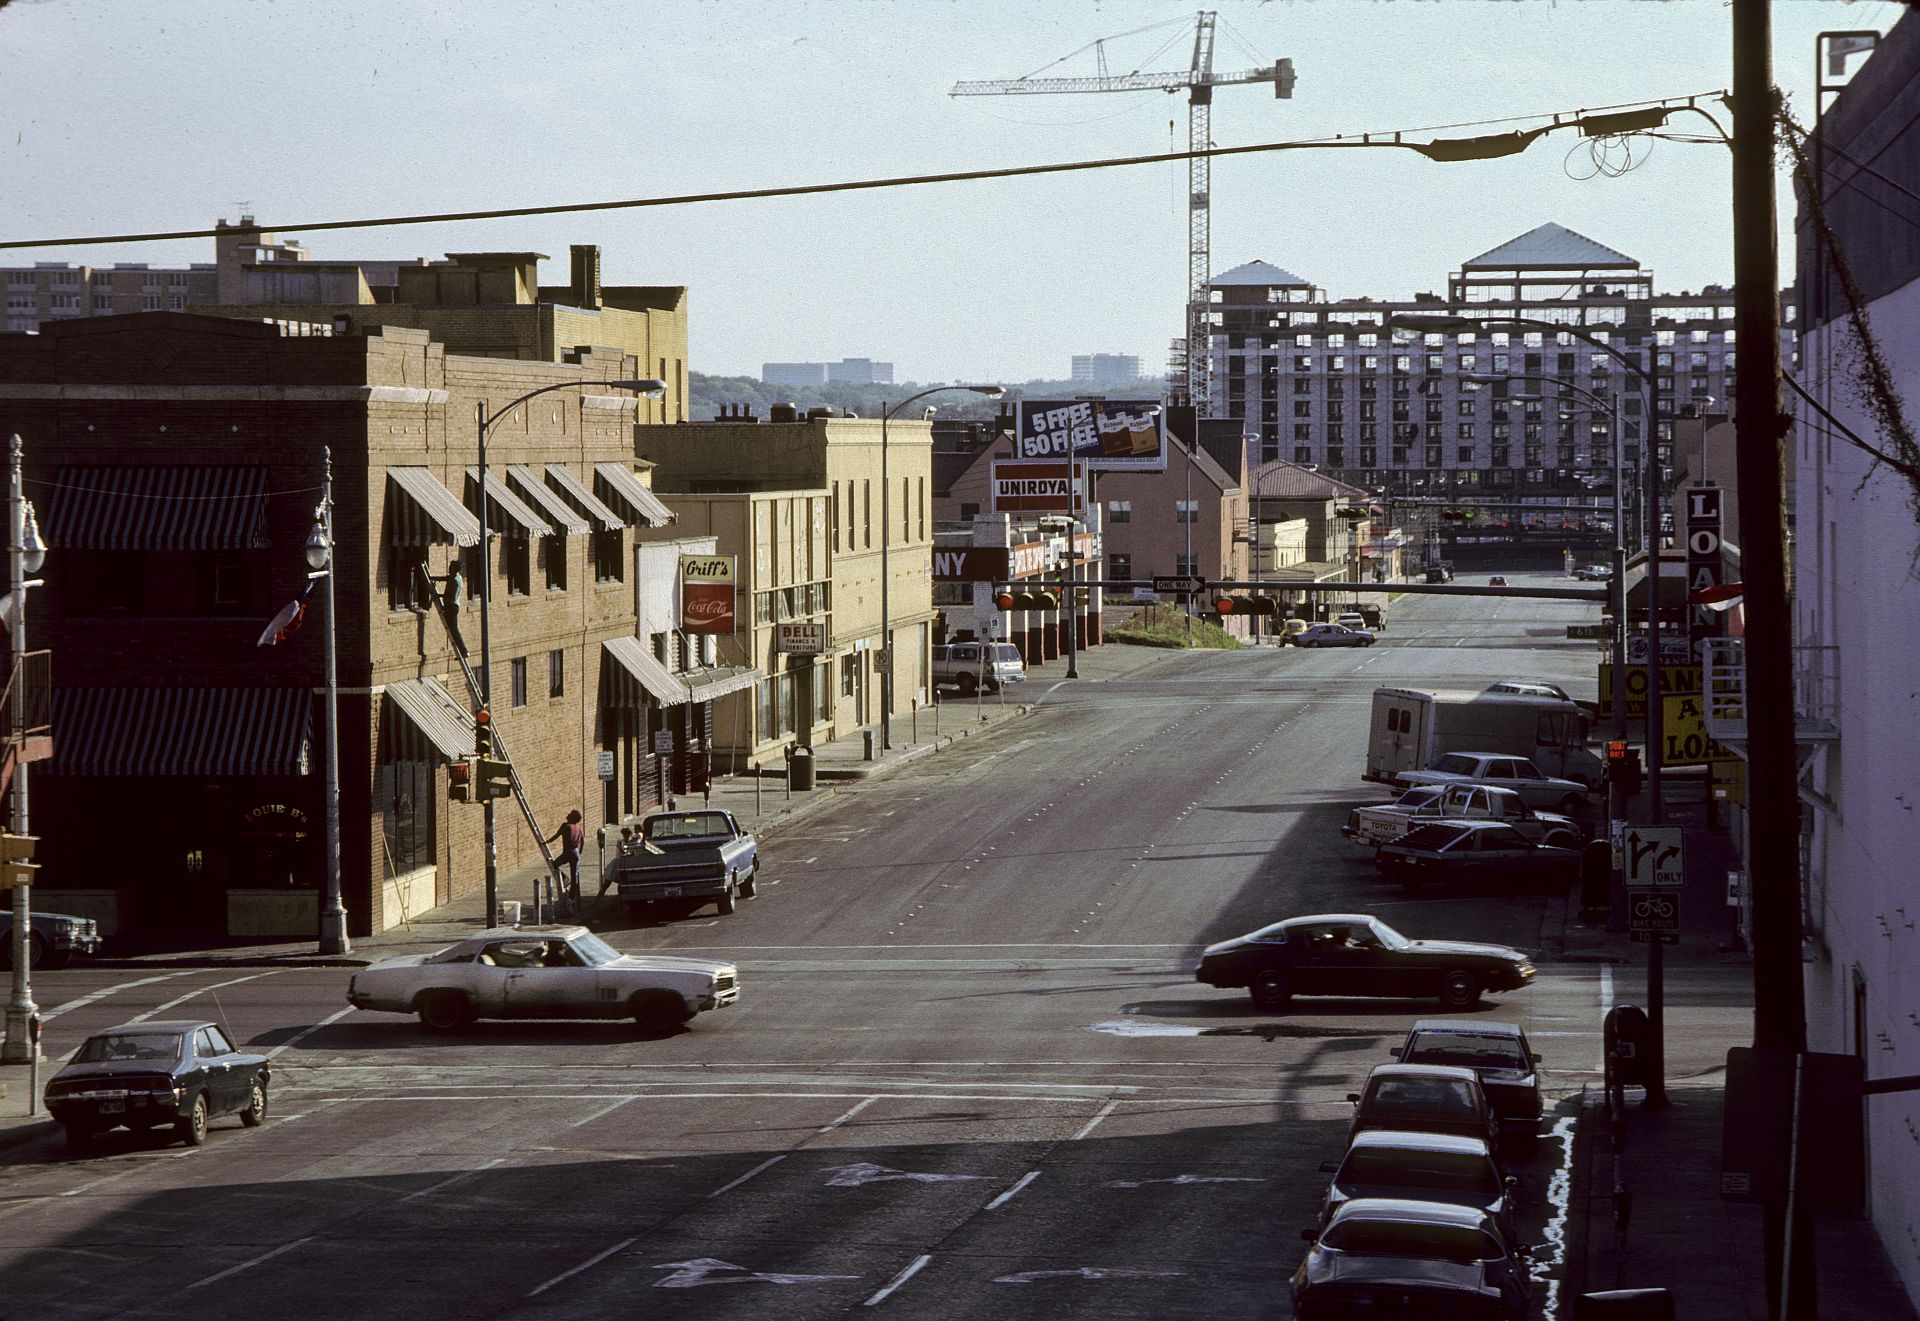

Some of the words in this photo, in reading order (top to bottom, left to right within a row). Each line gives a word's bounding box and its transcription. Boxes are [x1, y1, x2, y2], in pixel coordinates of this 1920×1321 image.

[1032, 413, 1047, 432] 5
[1047, 402, 1092, 430] FREE
[1024, 434, 1050, 456] 50
[1000, 480, 1077, 495] UNIROYA
[686, 560, 729, 576] Griff's
[783, 627, 816, 637] BELL
[1371, 822, 1397, 832] TOYOTA
[1656, 872, 1682, 882] ONLY
[1632, 919, 1649, 928] BIKE
[1651, 919, 1675, 928] ROUTE
